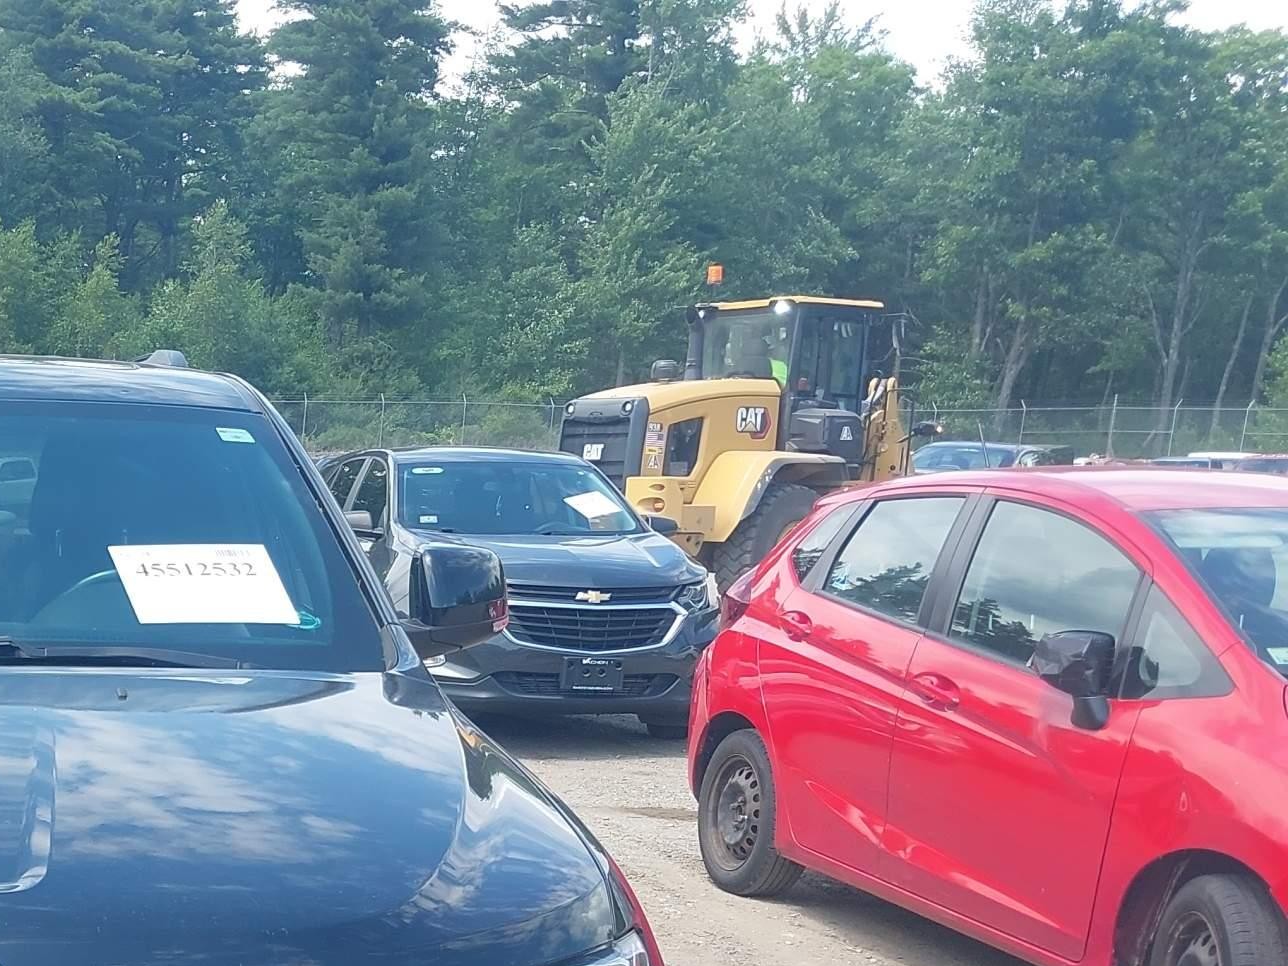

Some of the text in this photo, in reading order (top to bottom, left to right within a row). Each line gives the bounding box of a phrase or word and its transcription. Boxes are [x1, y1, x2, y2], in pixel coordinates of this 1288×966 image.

[736, 407, 764, 432] CAT
[583, 443, 605, 460] CAT
[136, 562, 257, 576] 45512532
